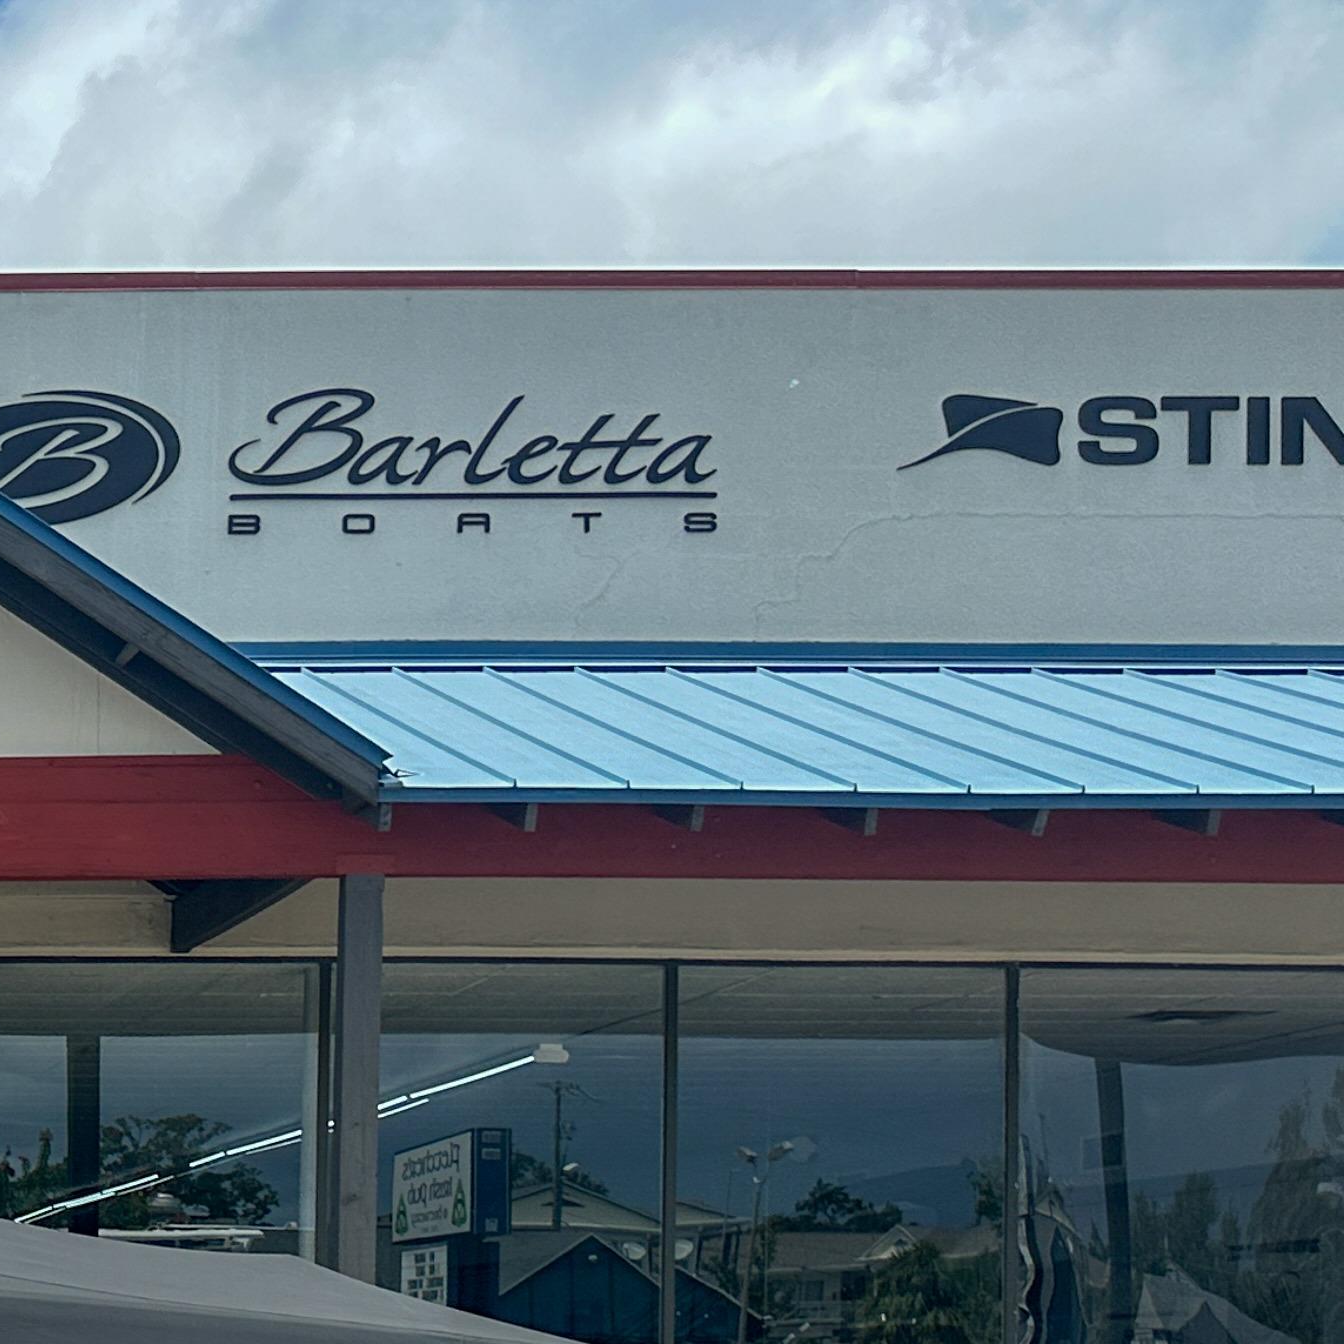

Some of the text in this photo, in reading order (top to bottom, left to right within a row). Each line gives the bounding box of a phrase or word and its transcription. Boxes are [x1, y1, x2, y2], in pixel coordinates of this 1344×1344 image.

[229, 388, 717, 488] Barletta
[1077, 396, 1344, 466] STIN
[228, 513, 717, 536] BOATS
